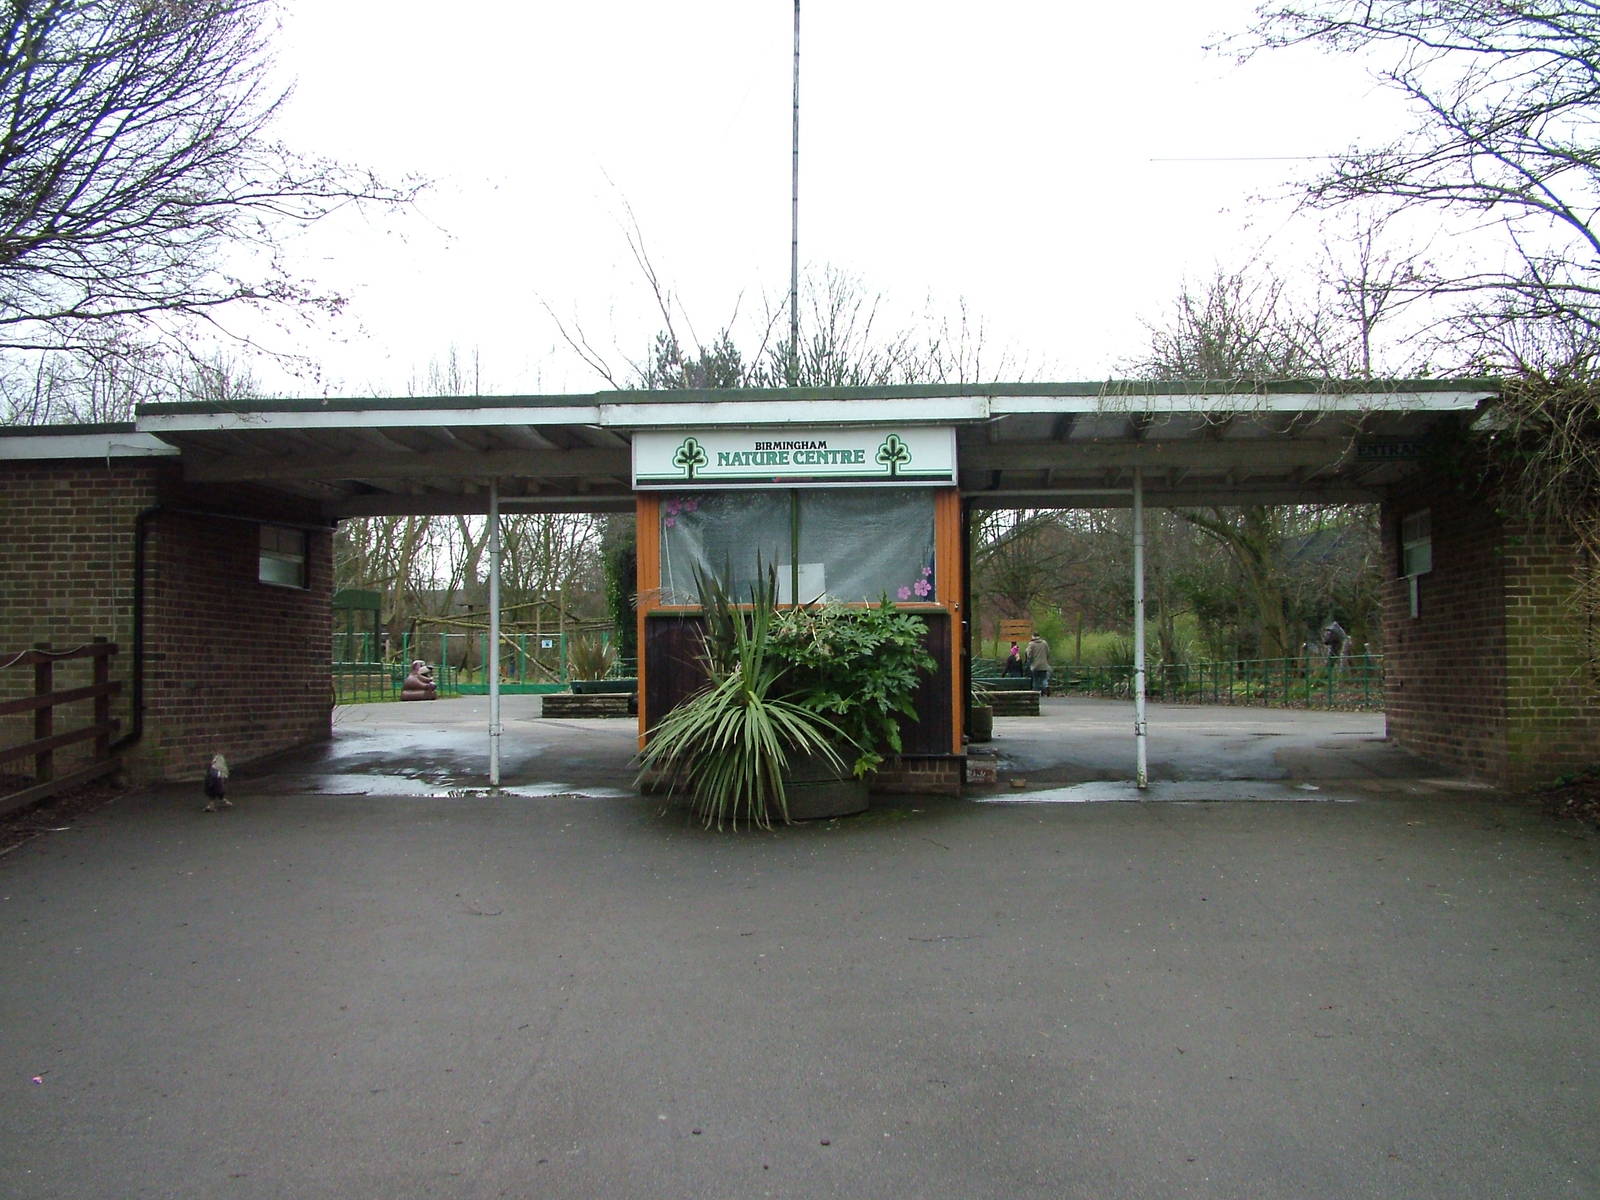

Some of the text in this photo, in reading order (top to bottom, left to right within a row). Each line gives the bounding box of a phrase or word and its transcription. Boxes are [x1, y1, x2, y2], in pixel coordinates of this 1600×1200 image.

[755, 441, 827, 450] BIRMINGHAM
[717, 450, 866, 466] NATURE CENTRE
